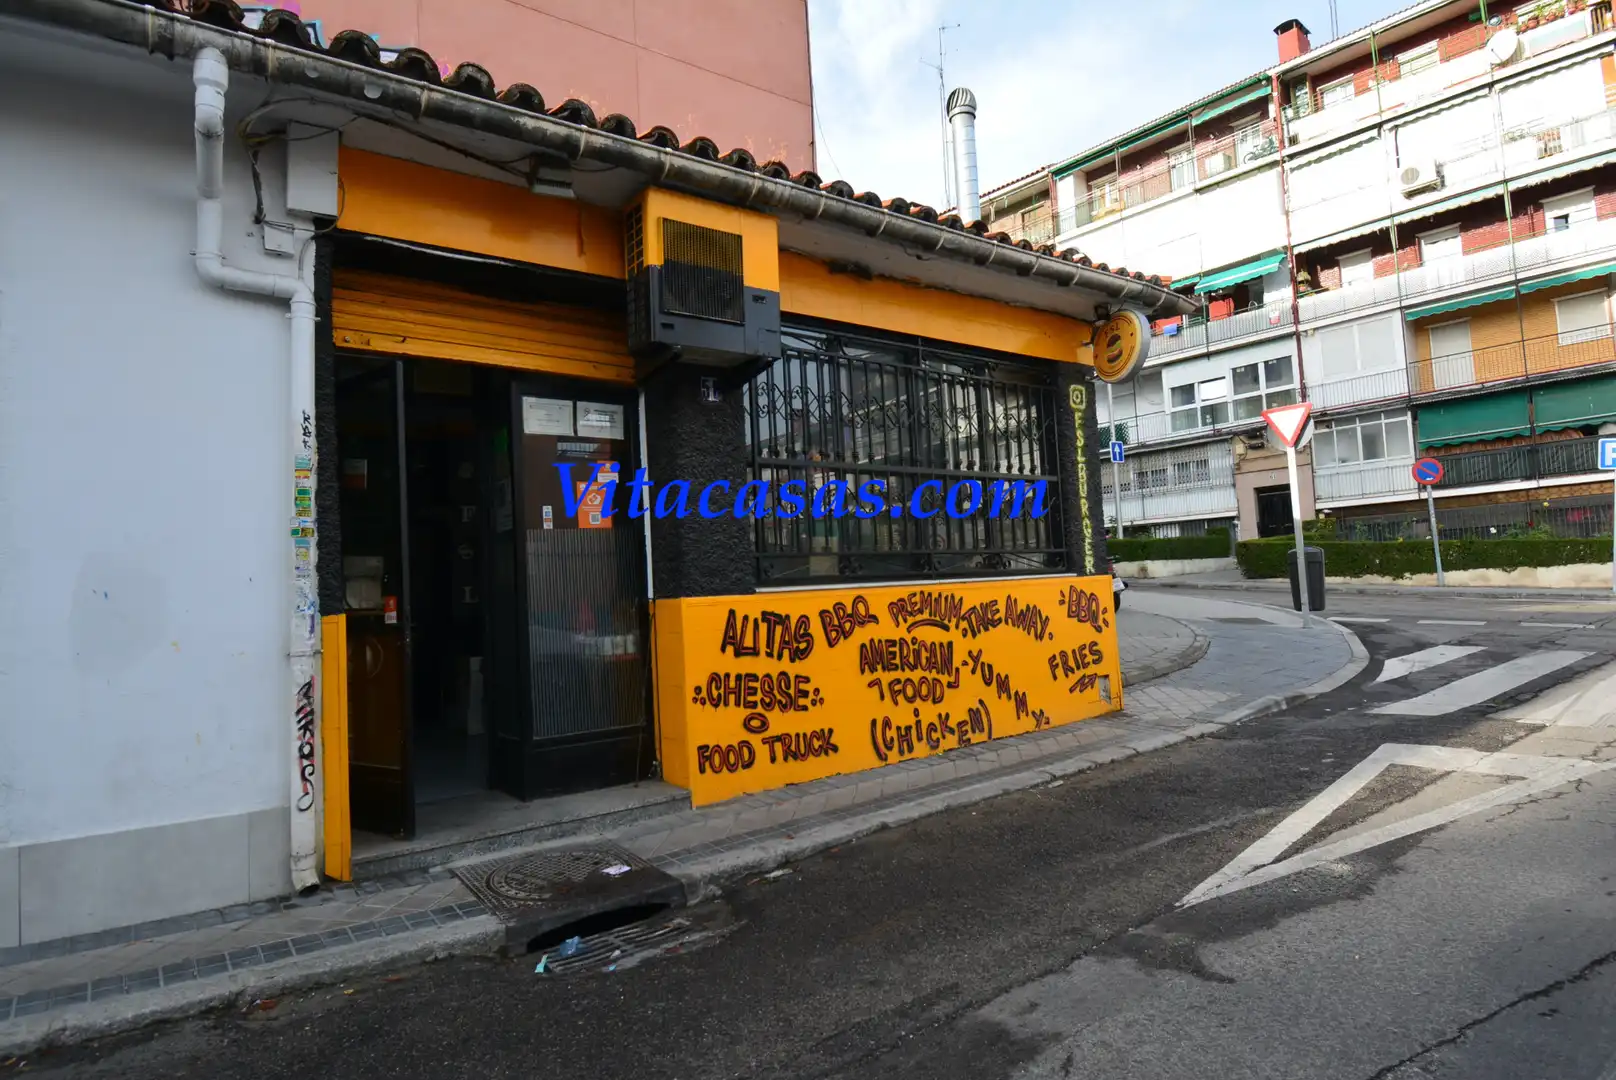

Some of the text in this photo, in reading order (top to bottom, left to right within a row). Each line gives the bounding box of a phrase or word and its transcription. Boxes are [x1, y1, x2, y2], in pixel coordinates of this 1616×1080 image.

[720, 595, 879, 663] ALITAS BBQ
[887, 590, 963, 630] PREMIUM
[1067, 585, 1103, 633] BBQ
[1048, 640, 1104, 681] FRIES
[888, 676, 945, 706] FOOD
[696, 728, 839, 774] FOOD TRUCK
